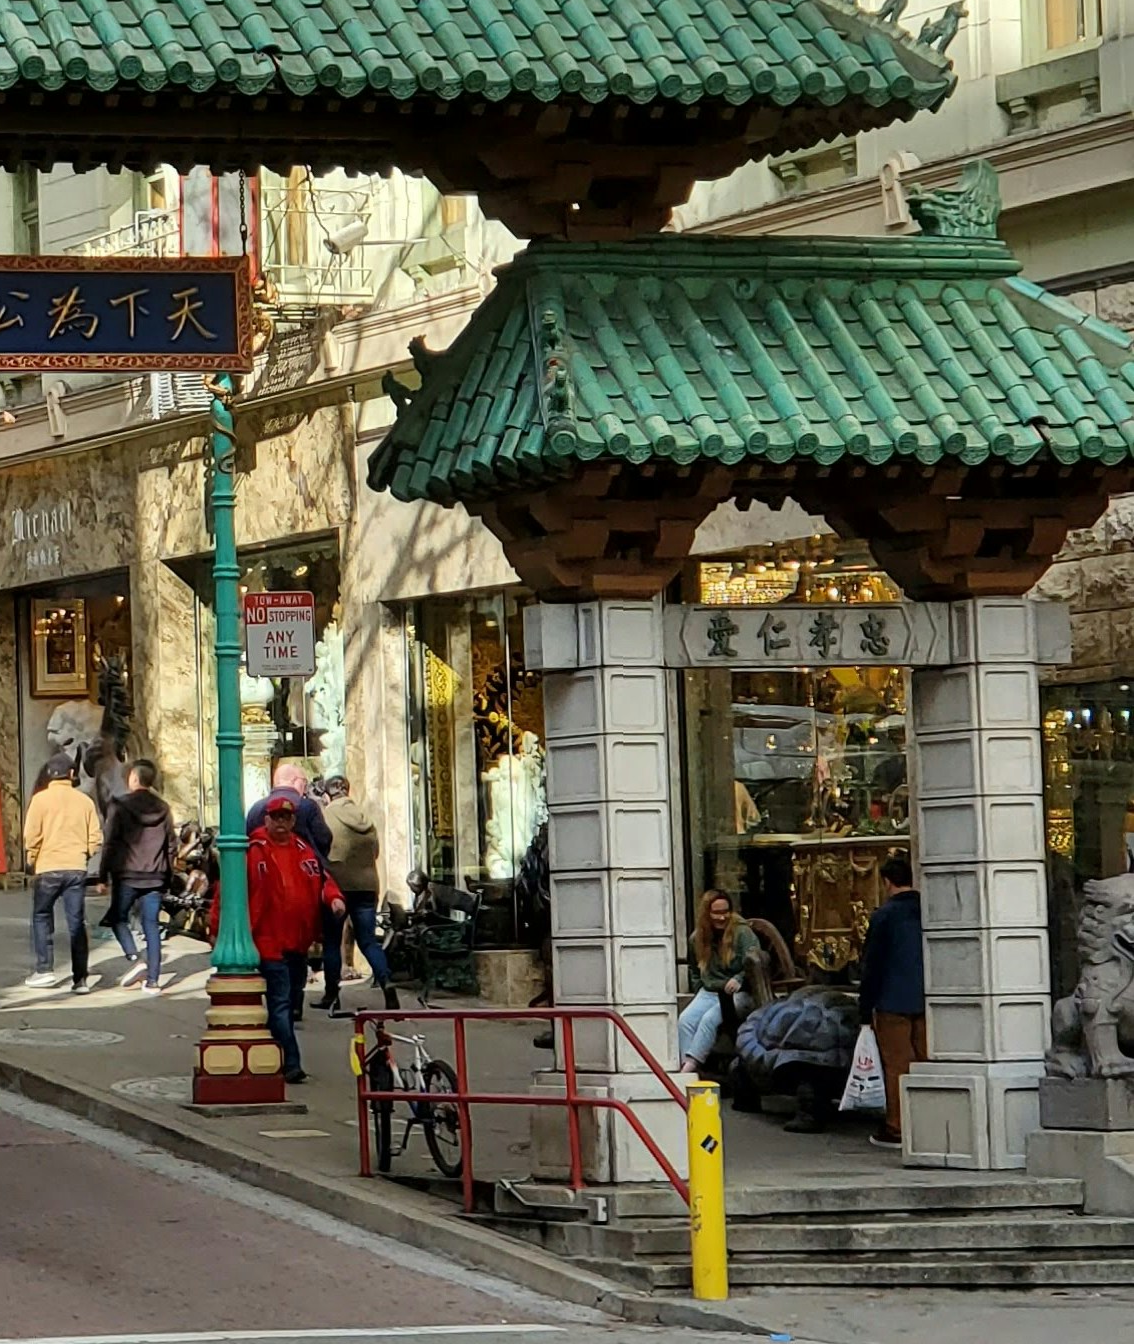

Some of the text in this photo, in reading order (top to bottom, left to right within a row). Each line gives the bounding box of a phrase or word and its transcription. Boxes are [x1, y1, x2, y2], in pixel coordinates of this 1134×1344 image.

[12, 501, 71, 546] Michael
[254, 595, 303, 606] TOW-AWAY
[246, 607, 311, 623] NO STOPPING
[266, 630, 295, 644] ANY
[263, 645, 298, 659] TIME
